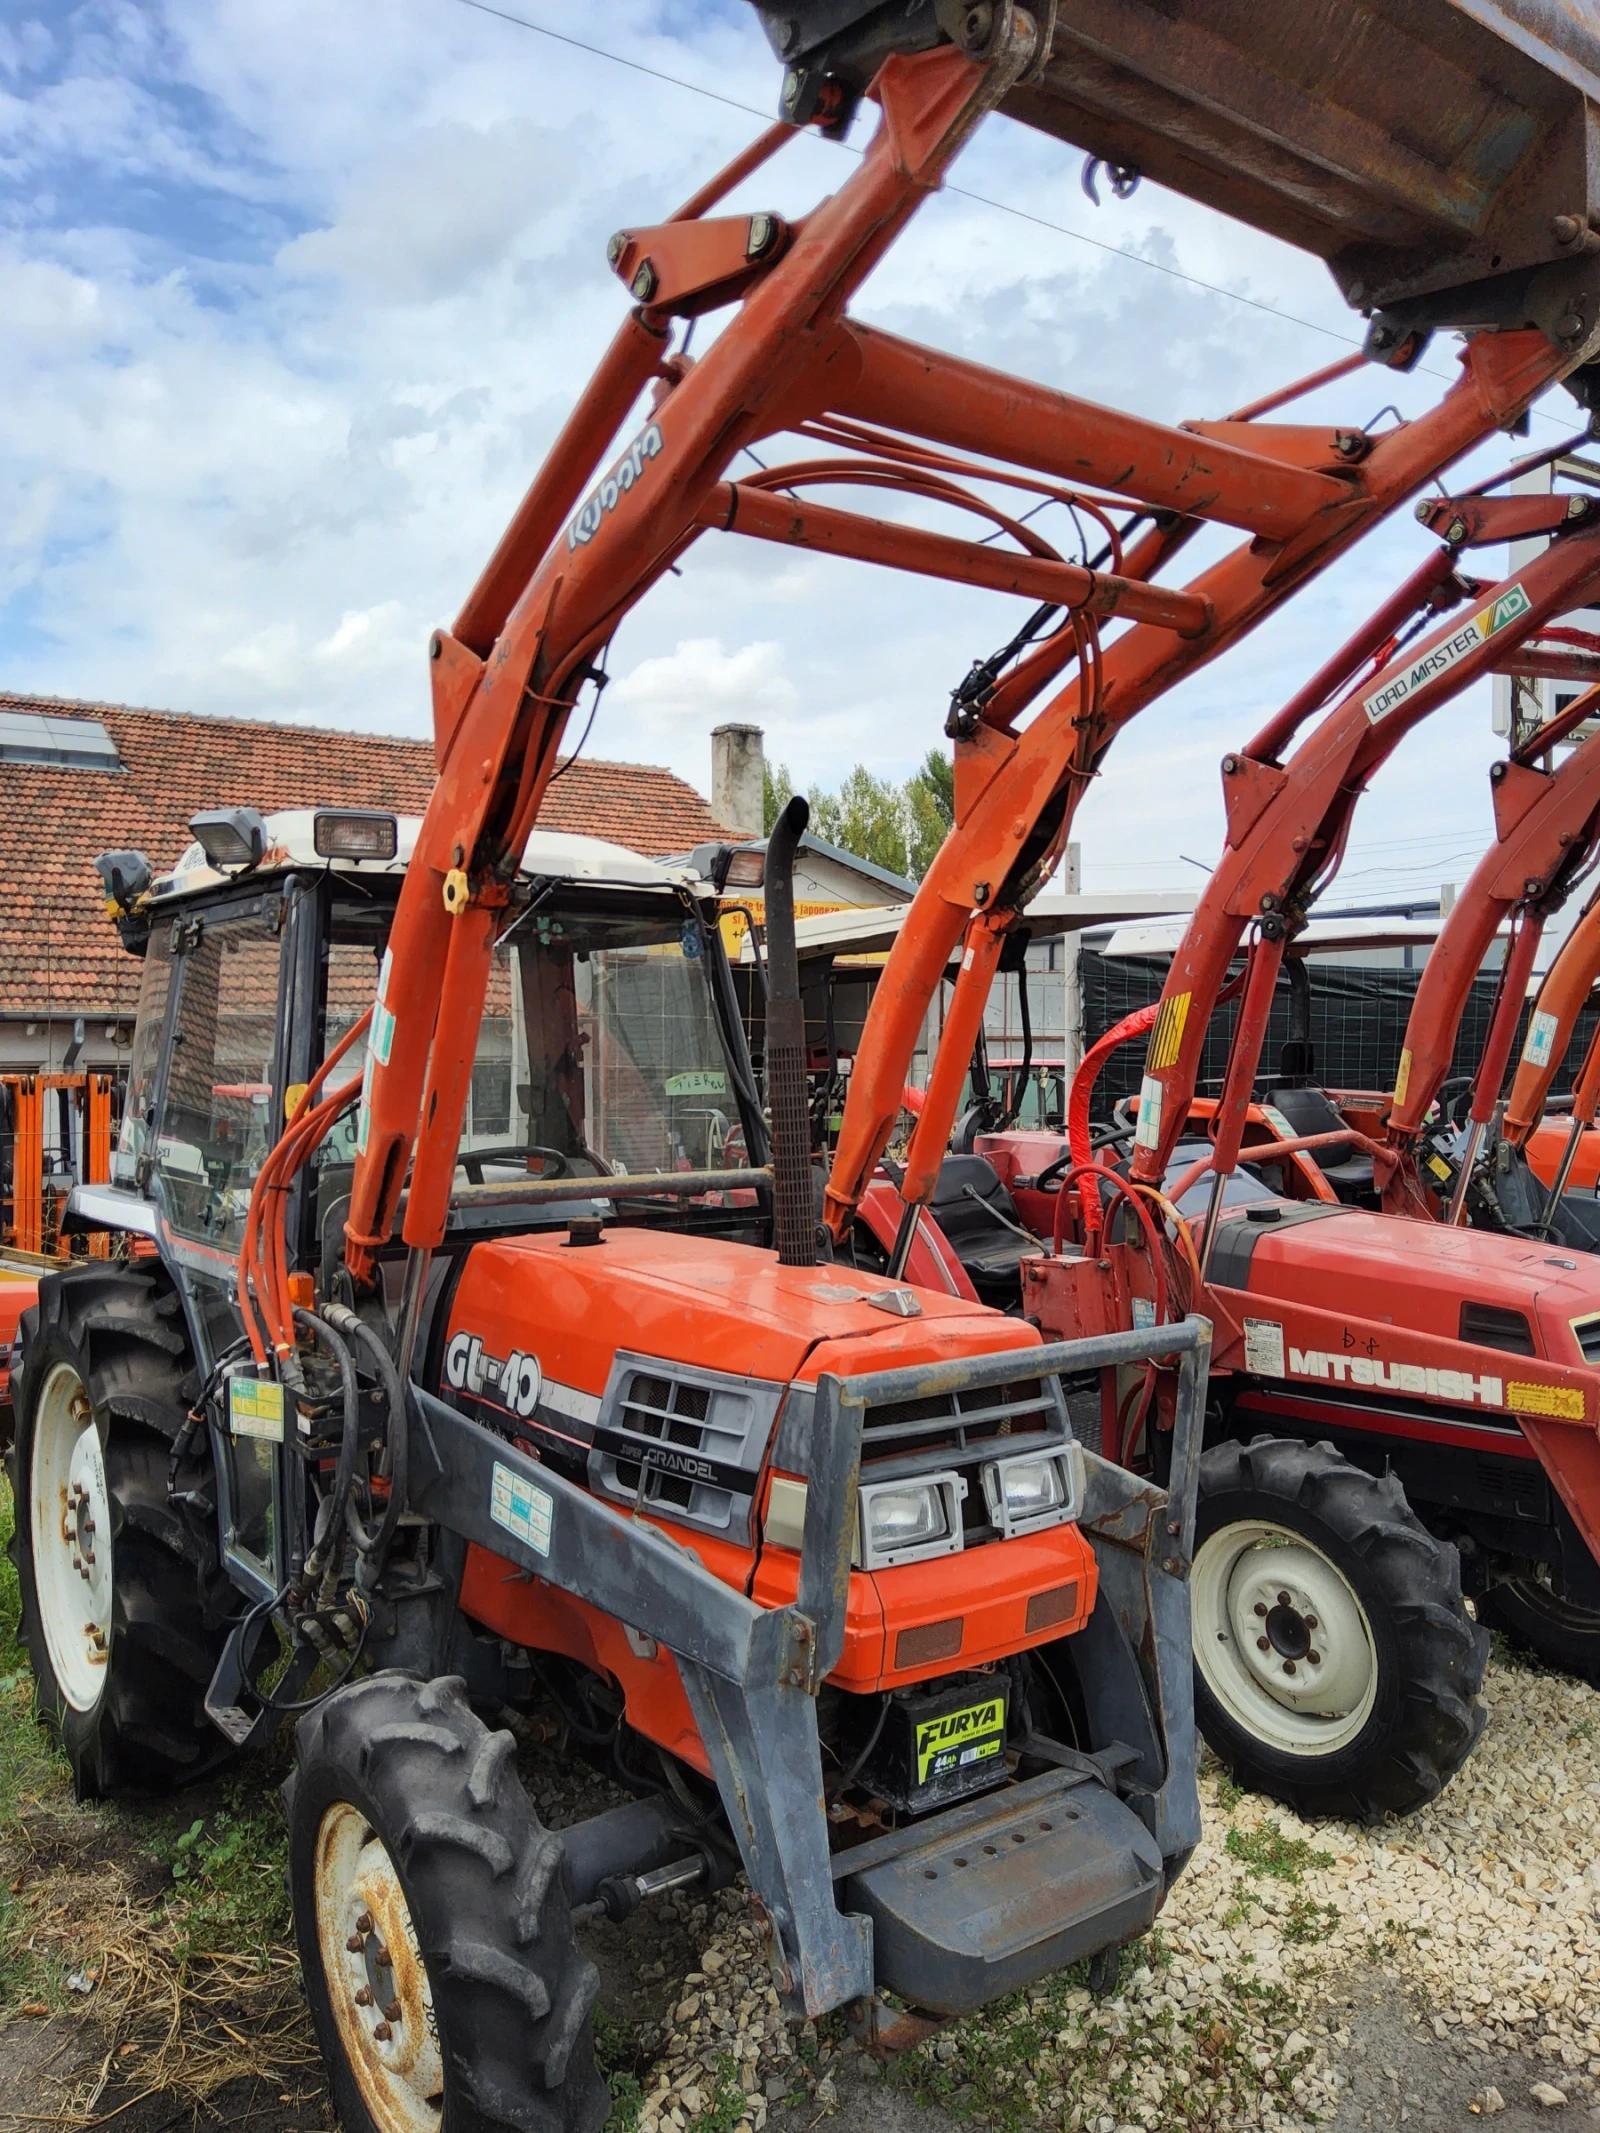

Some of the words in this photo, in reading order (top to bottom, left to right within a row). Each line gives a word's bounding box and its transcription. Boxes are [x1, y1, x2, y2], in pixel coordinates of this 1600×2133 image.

[567, 422, 664, 551] Kubota
[1367, 680, 1409, 719] LOAD
[1409, 624, 1481, 688] MASTER
[446, 1331, 542, 1417] GL-40
[1289, 1347, 1503, 1406] MITSUBISHI
[619, 1443, 643, 1459] SUPER
[646, 1447, 718, 1481] GRANDEL
[918, 1704, 997, 1756] FURYA
